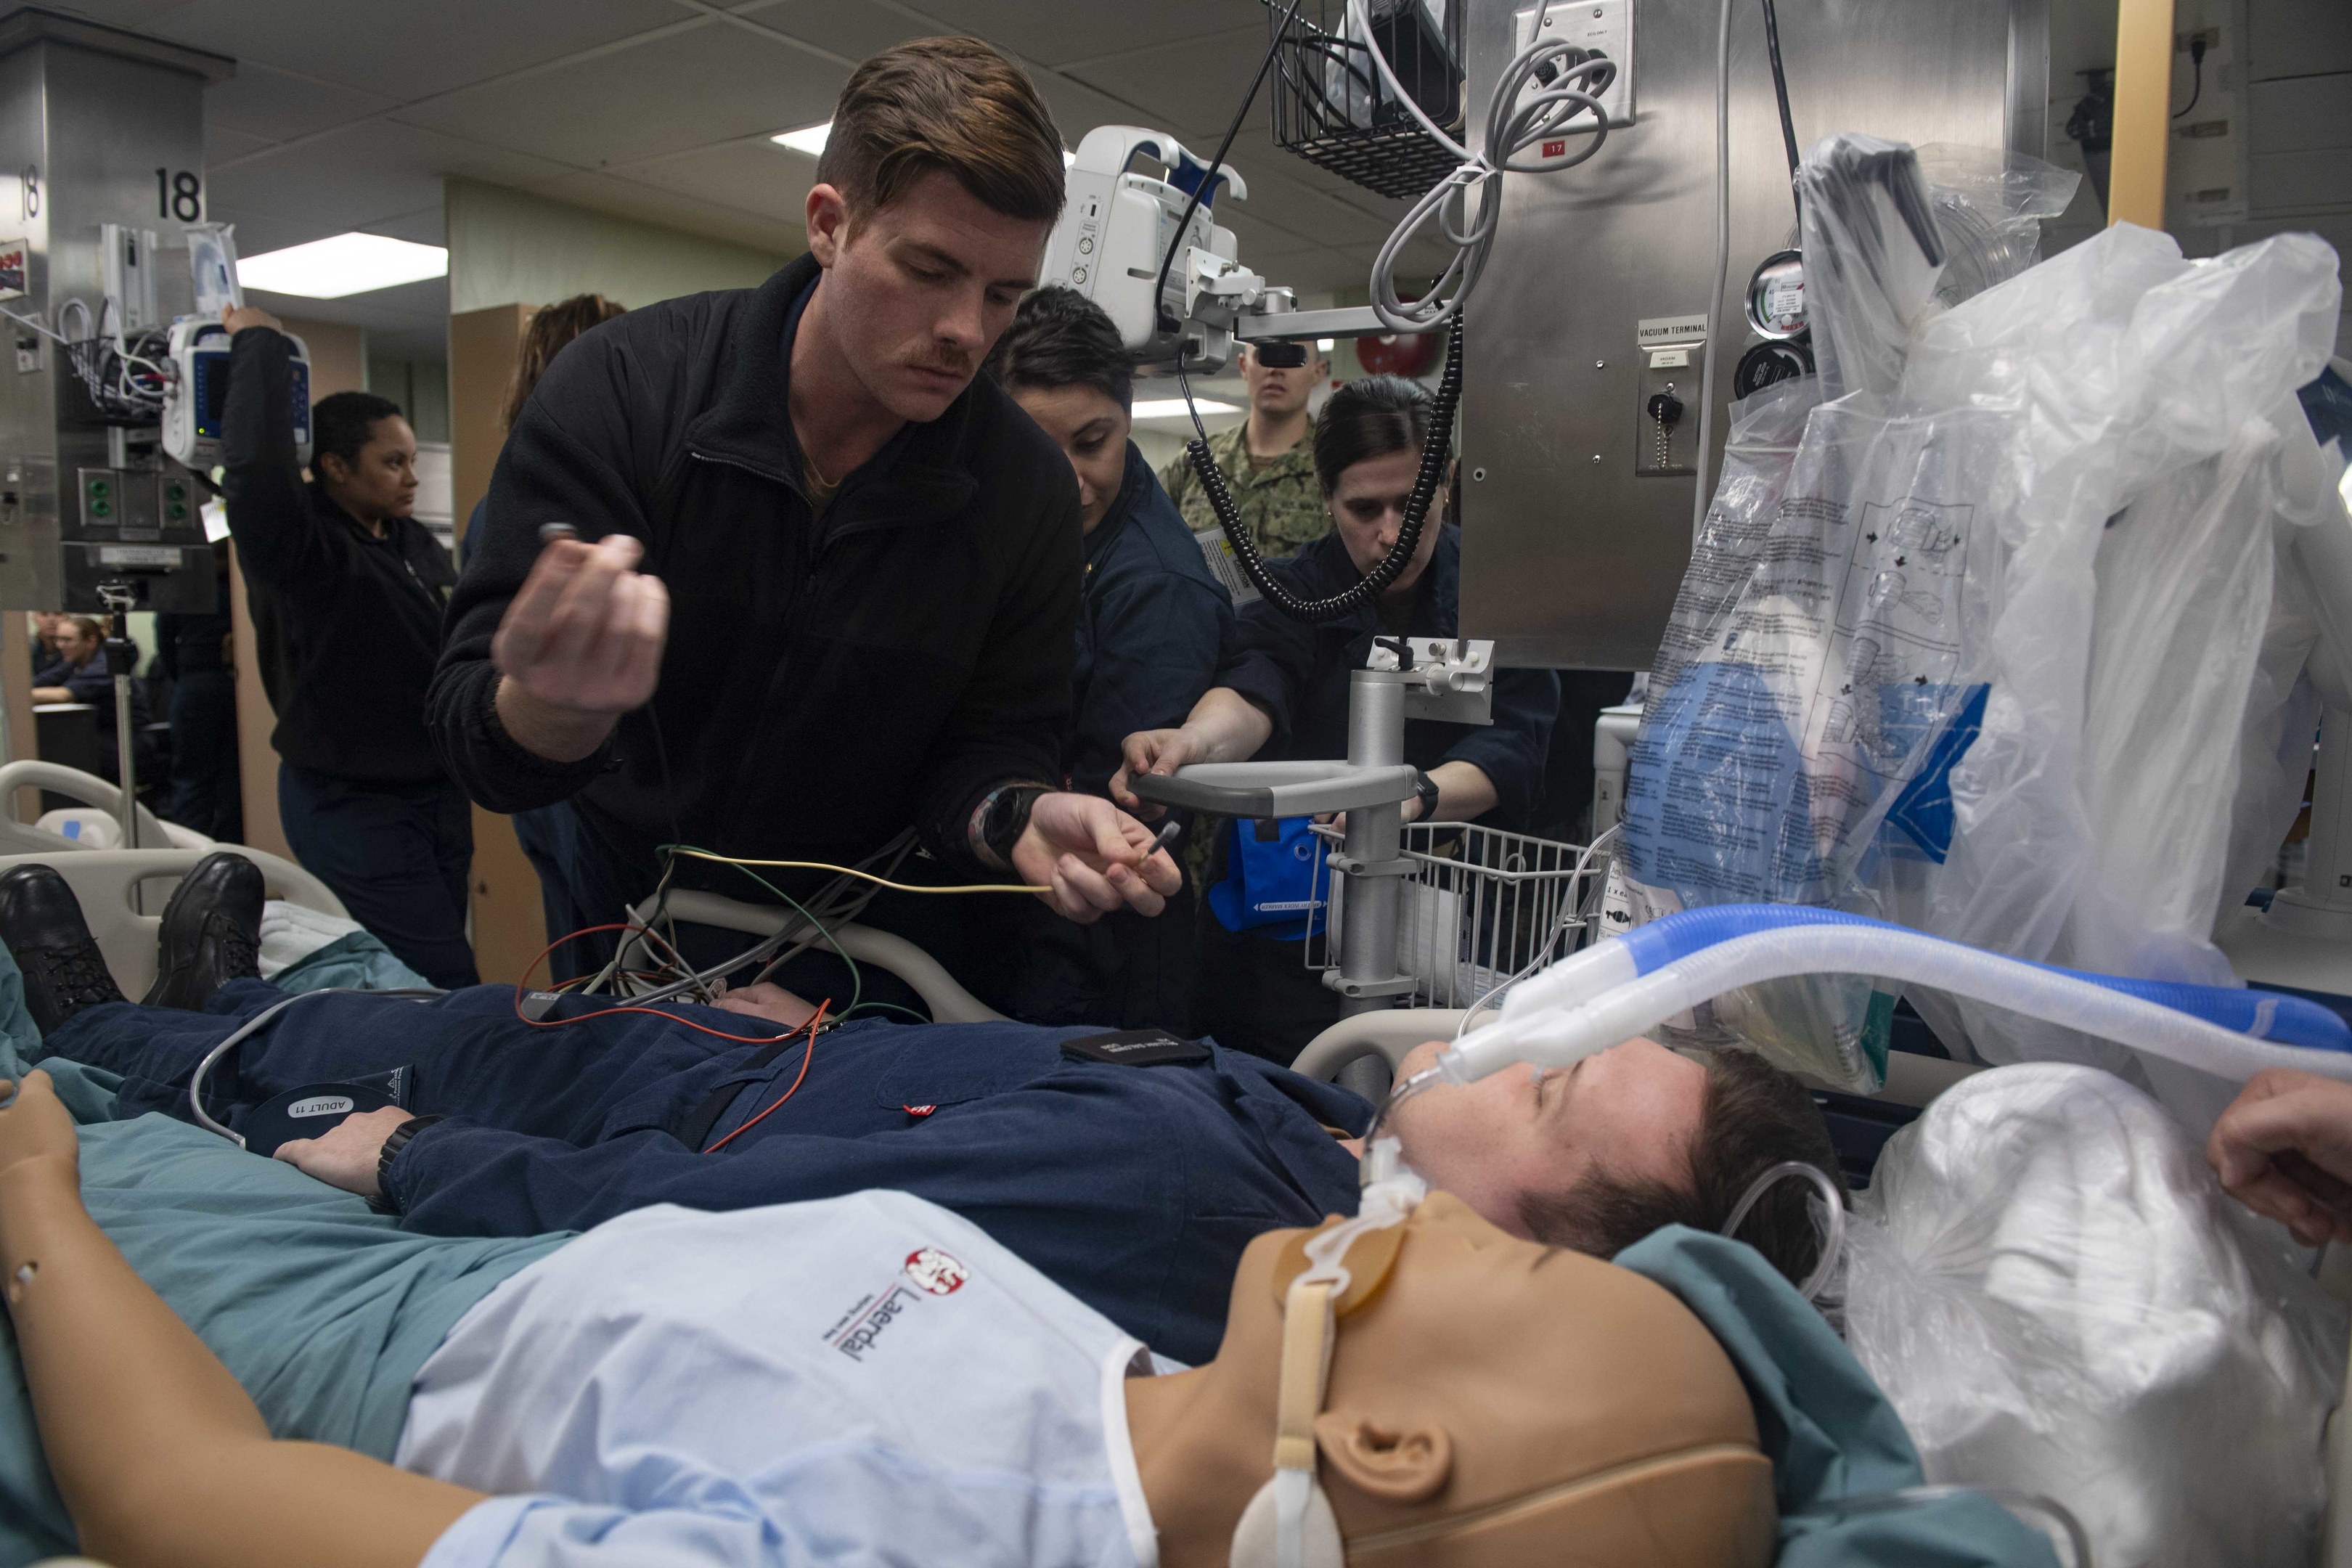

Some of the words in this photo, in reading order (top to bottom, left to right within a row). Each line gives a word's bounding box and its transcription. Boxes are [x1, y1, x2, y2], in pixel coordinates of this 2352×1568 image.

[1551, 144, 1562, 153] 17
[20, 164, 38, 221] 18
[155, 167, 200, 223] 18
[1640, 327, 1669, 337] VACUUM
[1671, 324, 1706, 335] TERMINAL
[1233, 559, 1251, 588] CAUTION
[309, 1101, 346, 1113] ADULT
[838, 1286, 921, 1363] Laerdal
